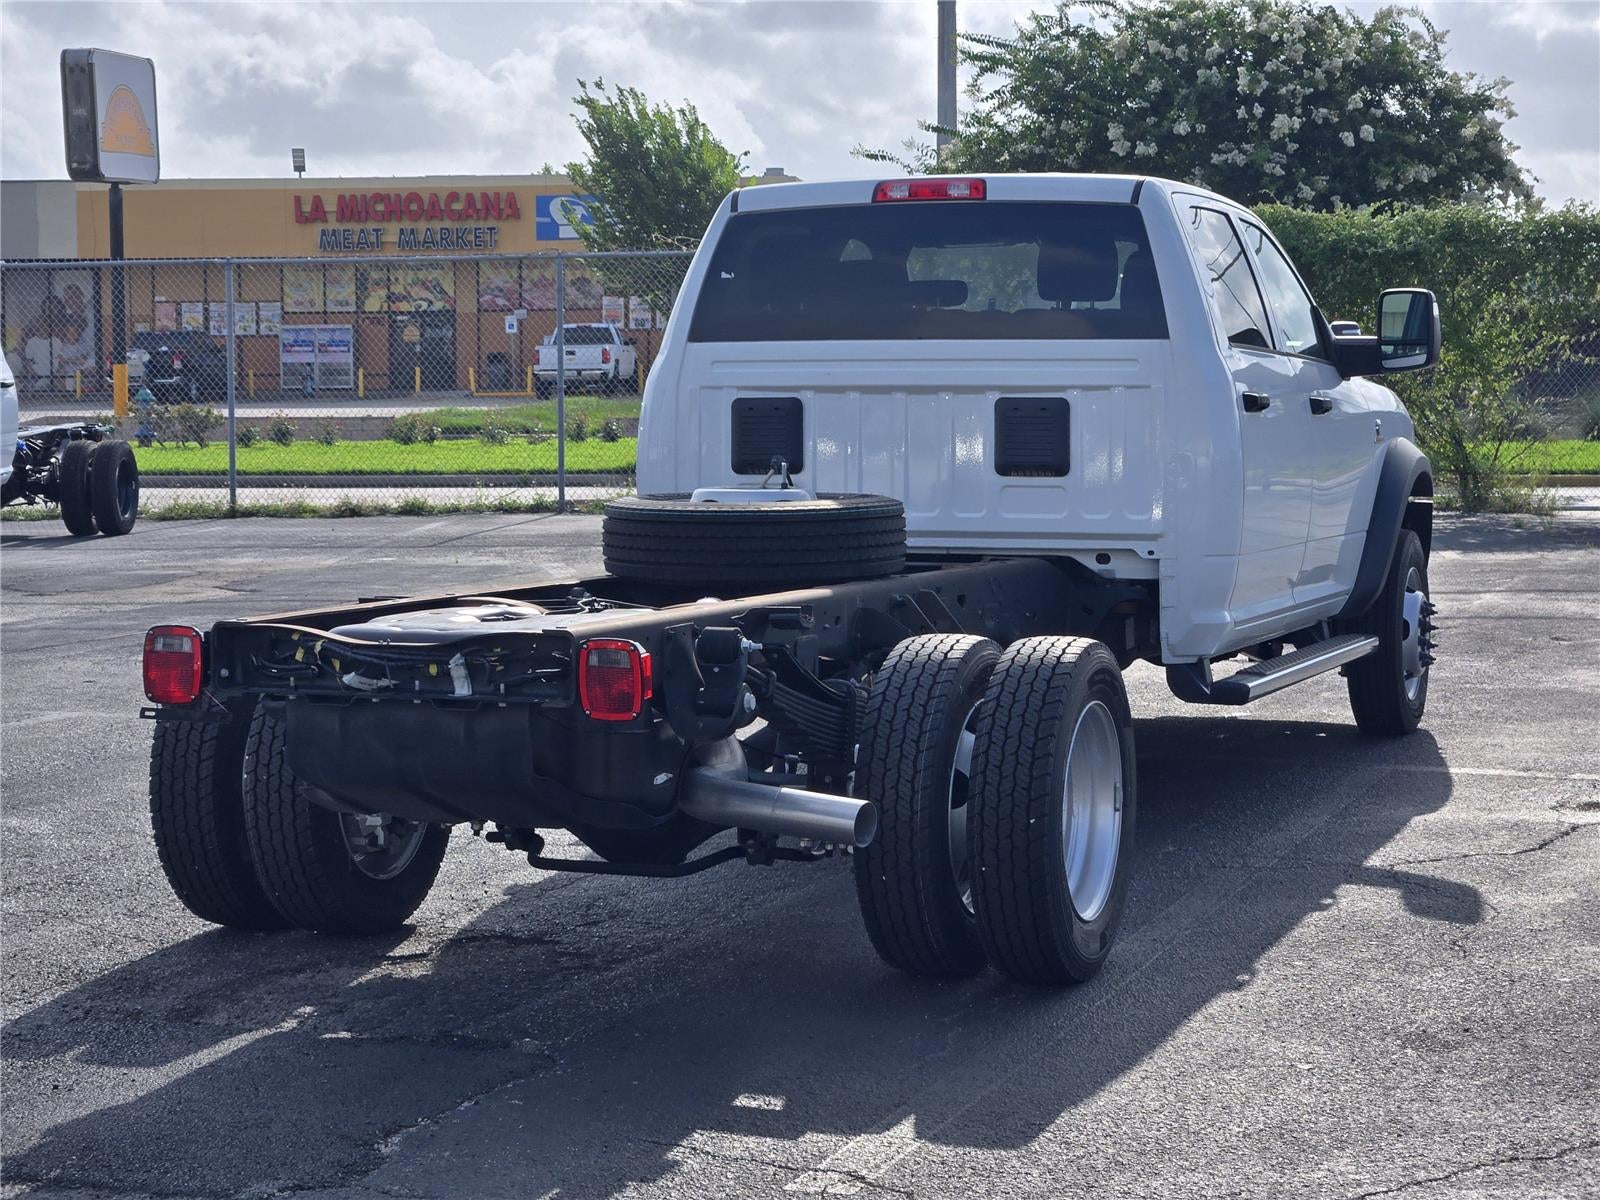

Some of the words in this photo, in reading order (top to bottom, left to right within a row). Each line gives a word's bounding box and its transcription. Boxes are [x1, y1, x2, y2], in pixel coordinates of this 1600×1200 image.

[293, 194, 327, 224] LA
[335, 191, 521, 223] MICHOACANA
[319, 227, 383, 251] MEAT
[397, 227, 497, 249] MARKET
